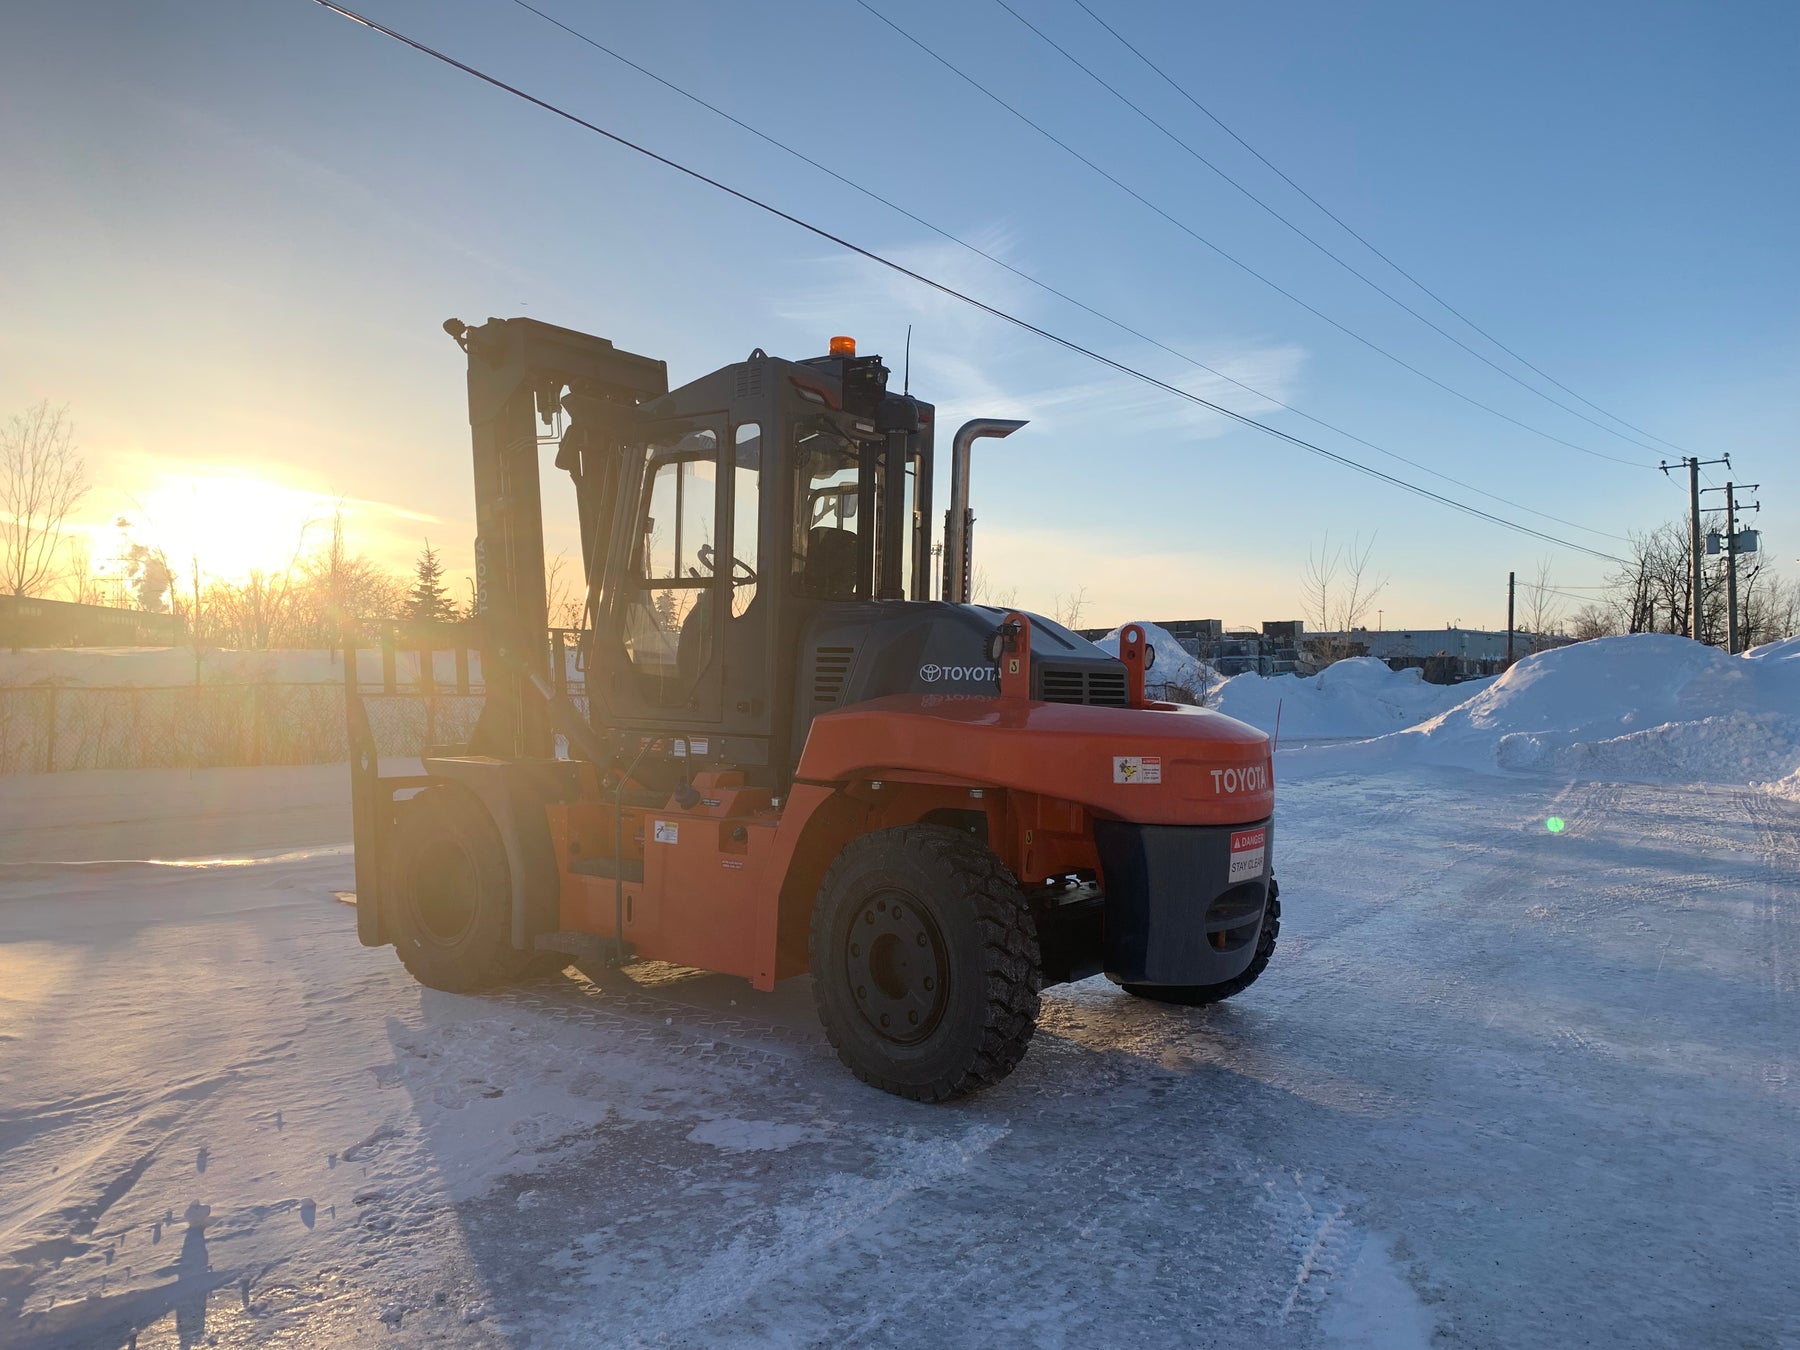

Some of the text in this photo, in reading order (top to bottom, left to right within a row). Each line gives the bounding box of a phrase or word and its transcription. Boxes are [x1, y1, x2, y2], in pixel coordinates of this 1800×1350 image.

[476, 539, 489, 614] TOYOTA
[1210, 765, 1267, 794] TOYOTA
[1241, 833, 1264, 847] DANGER
[1231, 861, 1247, 873] STAY
